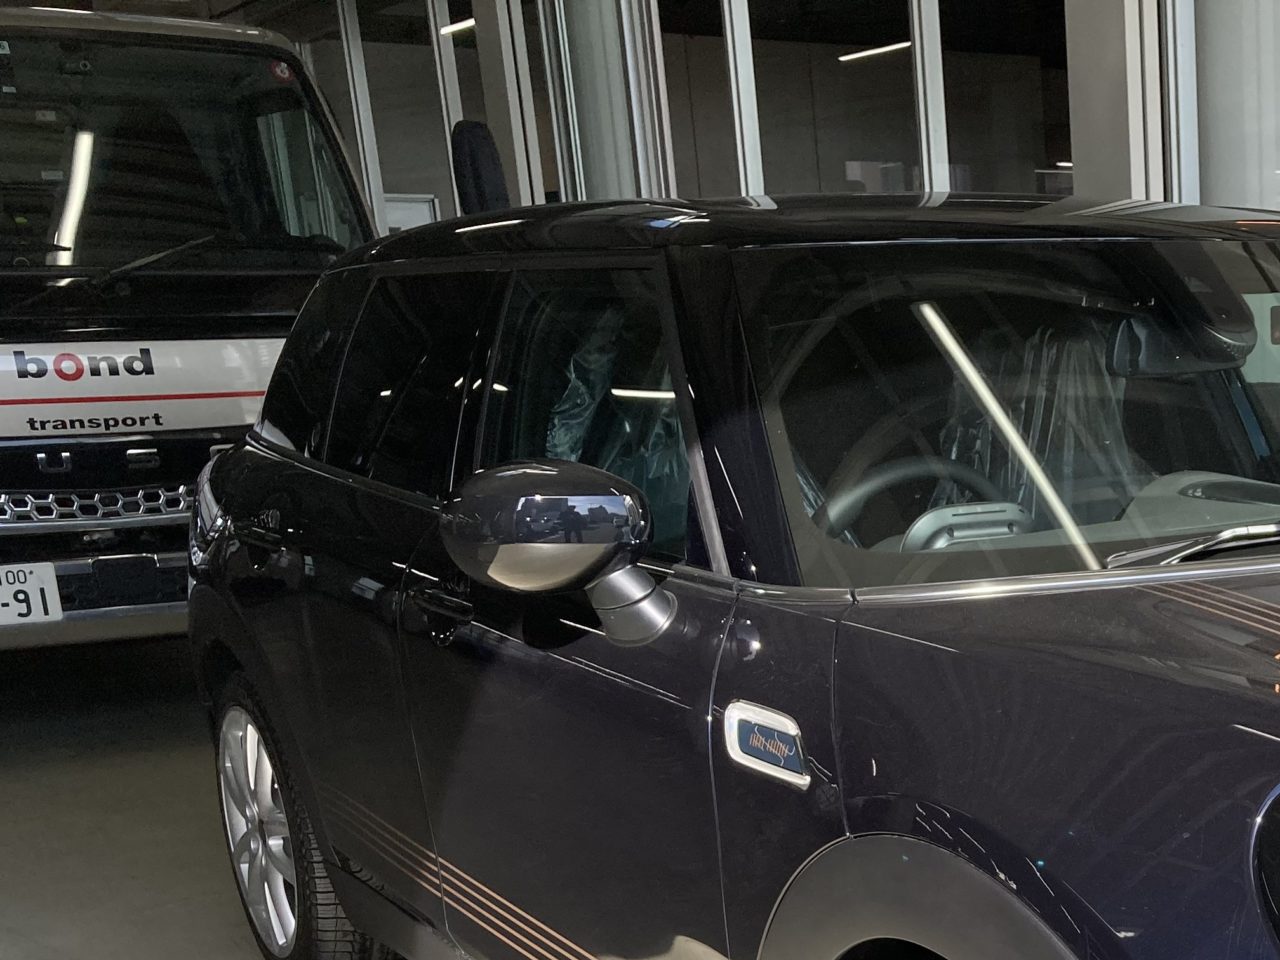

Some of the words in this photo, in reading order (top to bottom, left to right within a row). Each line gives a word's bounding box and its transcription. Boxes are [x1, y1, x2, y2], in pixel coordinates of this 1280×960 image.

[13, 348, 156, 381] bond
[26, 412, 164, 431] transport
[0, 569, 28, 587] 00
